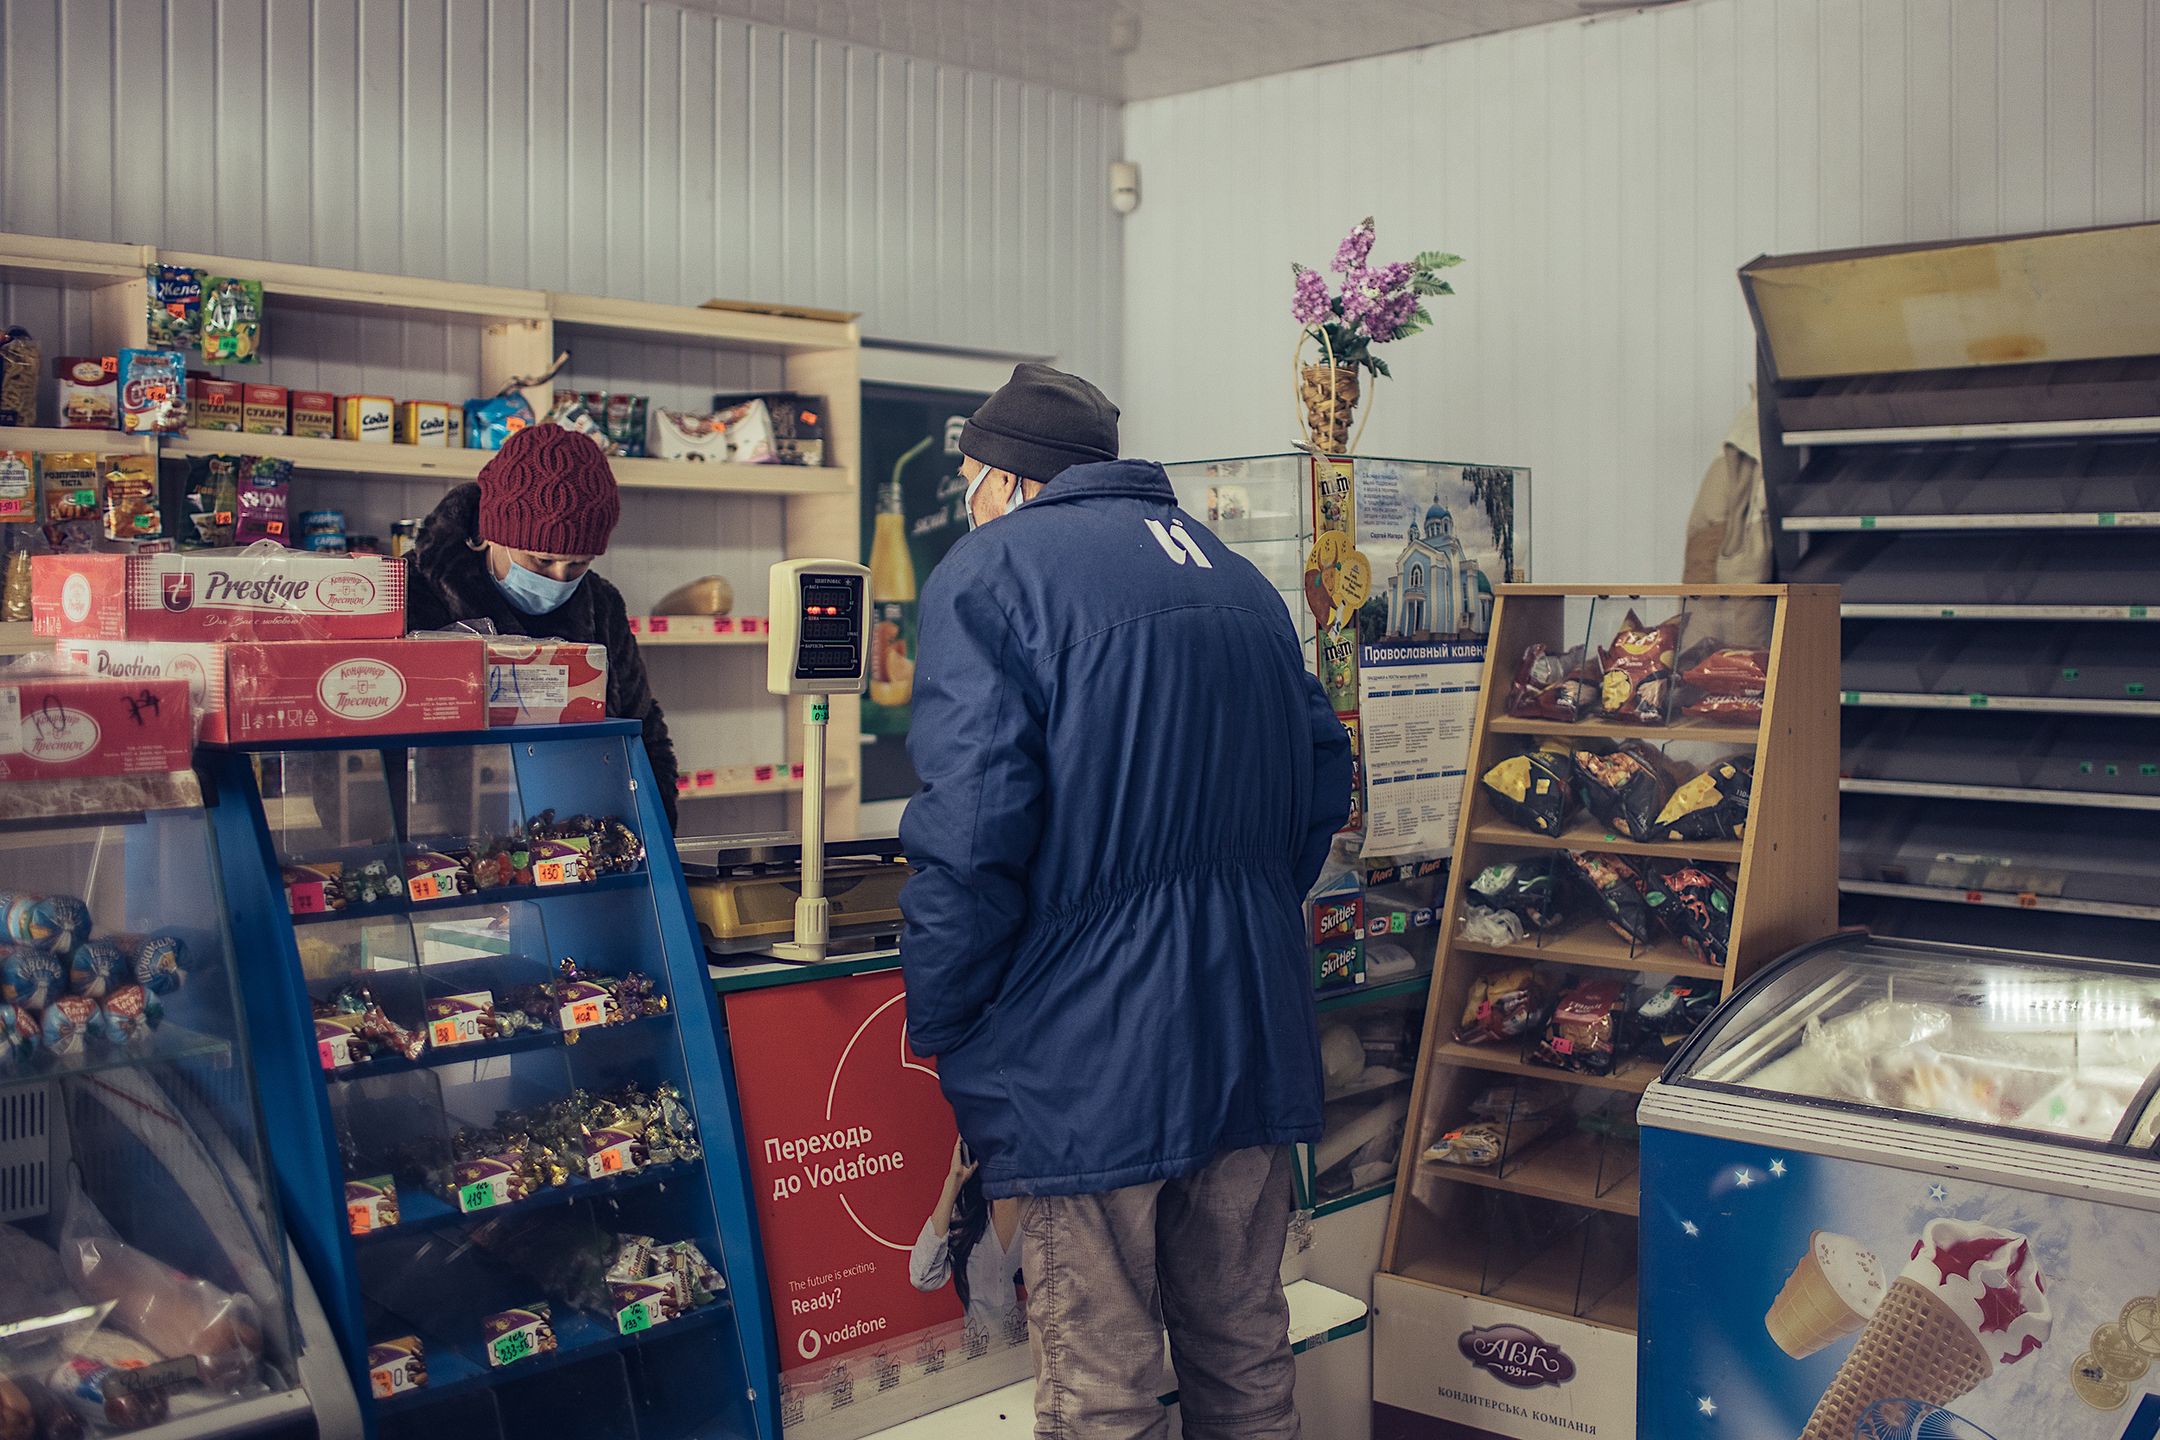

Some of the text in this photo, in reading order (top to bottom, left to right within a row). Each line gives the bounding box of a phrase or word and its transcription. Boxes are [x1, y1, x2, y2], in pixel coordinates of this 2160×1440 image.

[199, 403, 240, 415] СУХАРИ
[246, 407, 285, 419] СУХАРИ
[295, 412, 333, 424] СУХАРИ
[362, 411, 389, 425] Сода
[420, 417, 444, 430] Сода
[205, 571, 309, 608] Prestige
[1364, 643, 1449, 664] Православный
[340, 664, 386, 681] Кондитер
[336, 691, 390, 711] Престиж
[32, 737, 84, 755] Престиж
[1371, 867, 1394, 885] Mars
[1418, 858, 1441, 877] Mars
[1320, 902, 1357, 934] Skittles
[1320, 947, 1357, 979] Skittles
[763, 1125, 873, 1164] Переходь
[772, 1151, 905, 1201] до Vodafone
[788, 1261, 877, 1292] The future is exciting.
[791, 1287, 842, 1316] Ready?
[823, 1316, 887, 1345] vodafone
[1473, 1337, 1560, 1373] АВК
[1503, 1364, 1527, 1377] 1991
[1437, 1386, 1597, 1436] КОНДИТЕРСЬКА КОМПАНІЯ
